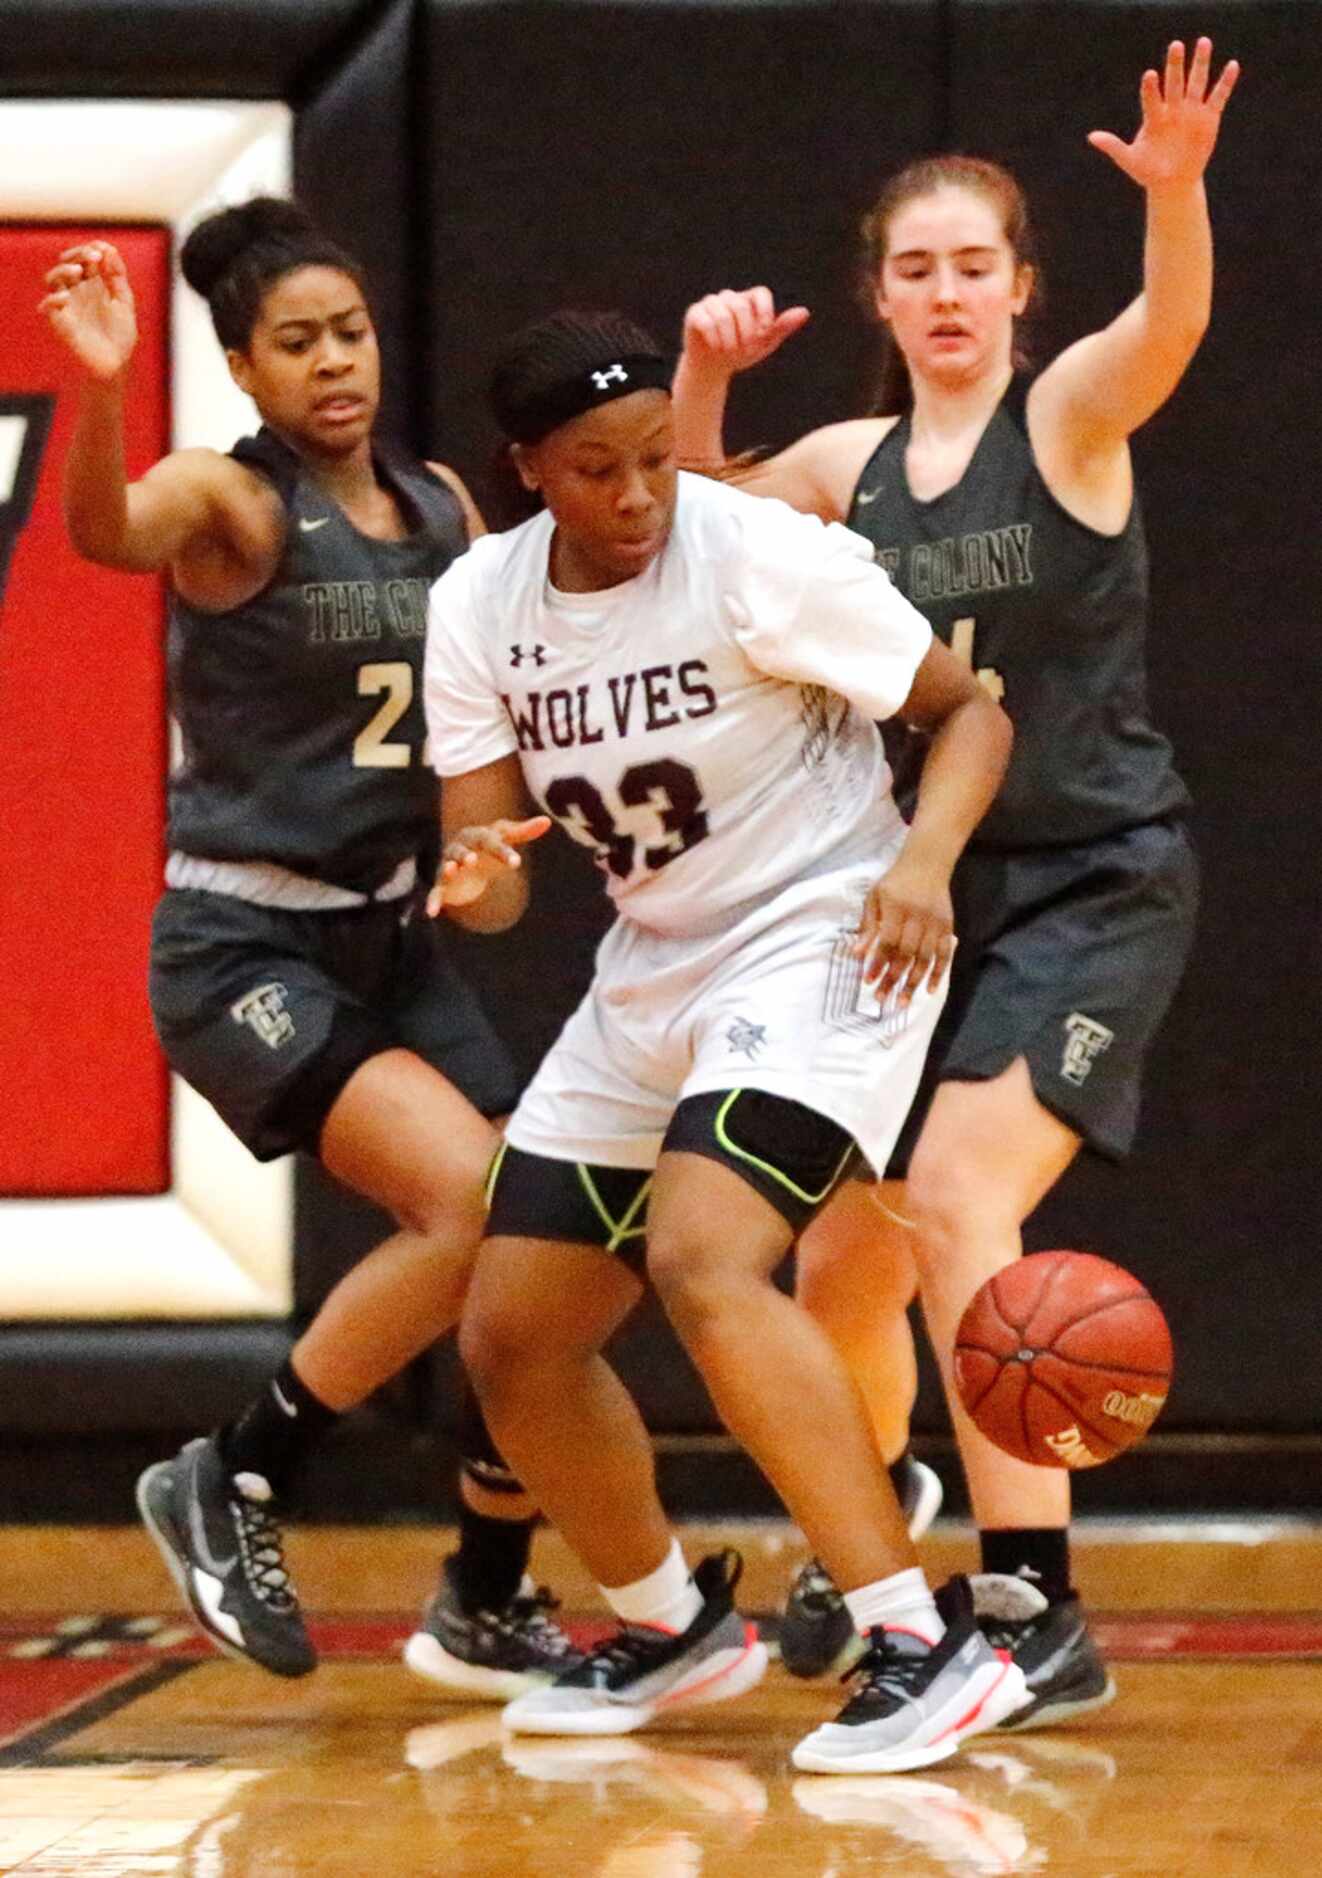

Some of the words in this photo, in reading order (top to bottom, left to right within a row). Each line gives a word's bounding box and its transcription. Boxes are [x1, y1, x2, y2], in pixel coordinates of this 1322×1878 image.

[910, 523, 1034, 602] COLONY
[303, 581, 382, 642] THE
[353, 662, 428, 767] 2
[500, 659, 717, 751] WOLVES
[545, 758, 710, 879] 33
